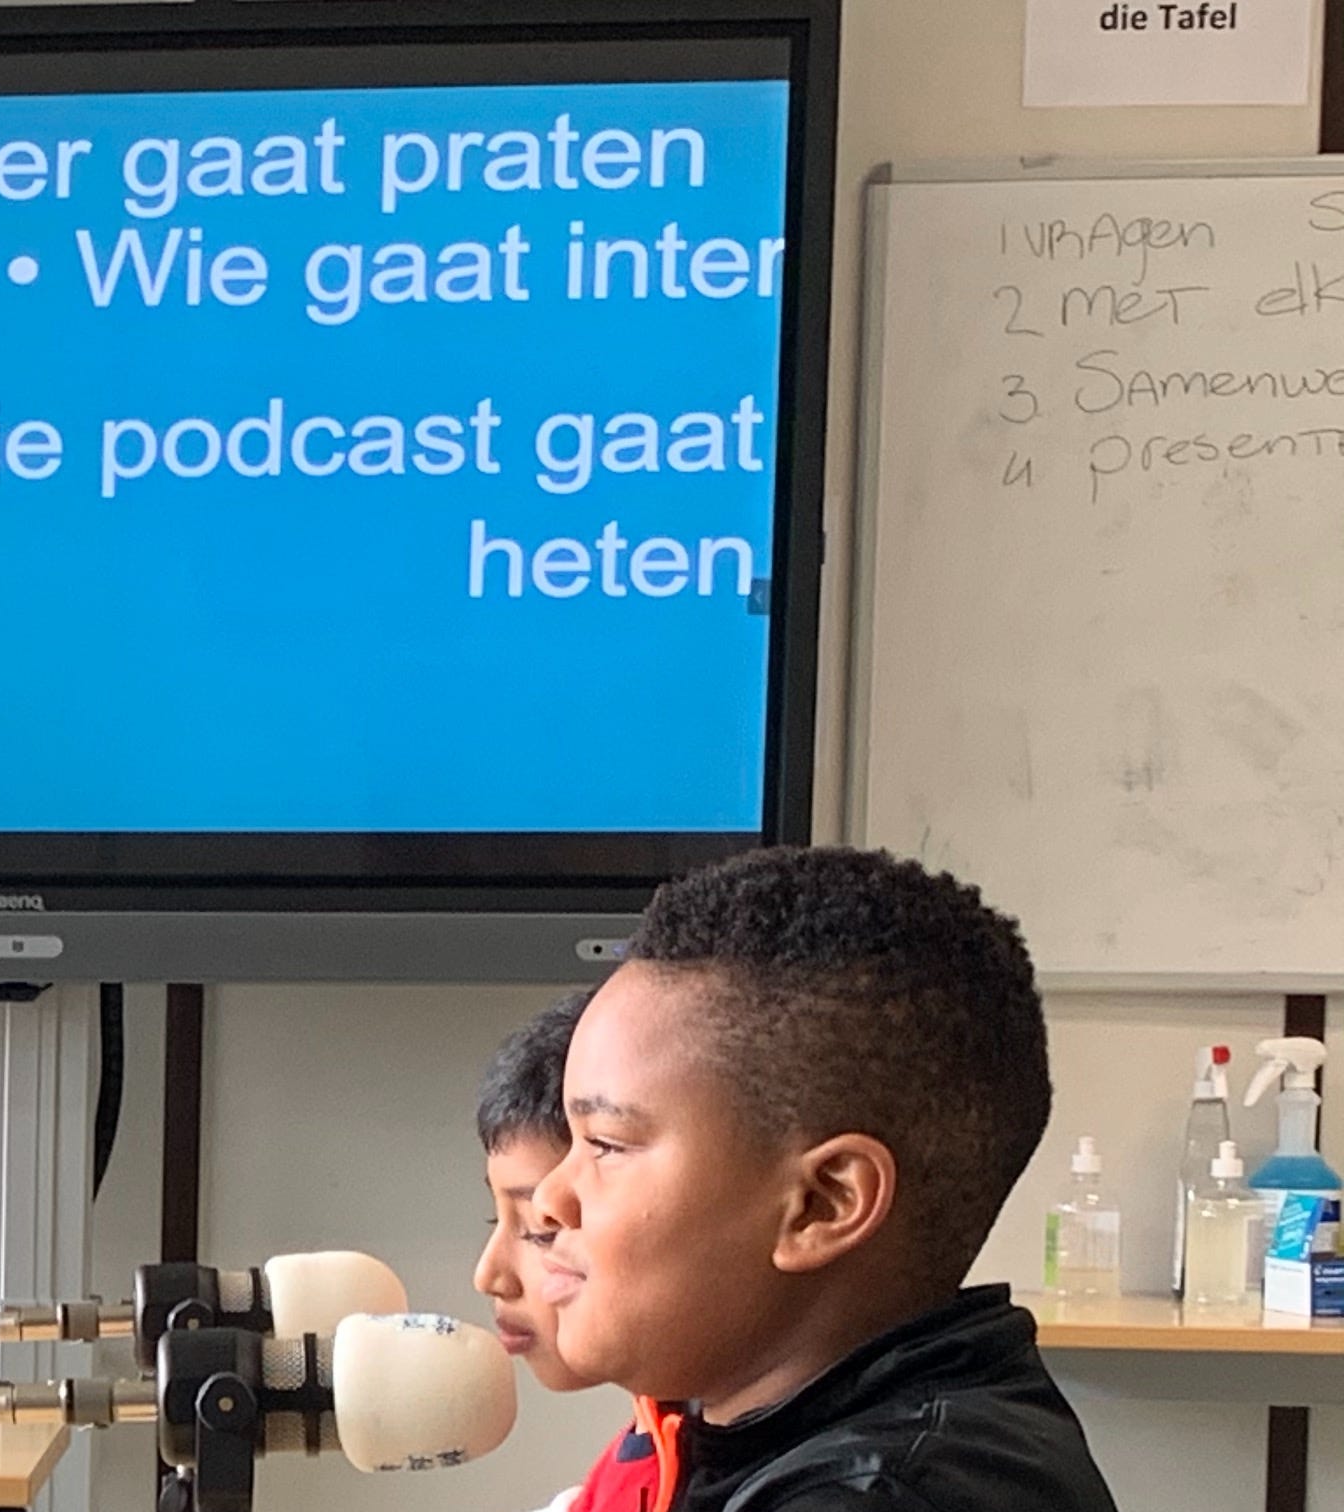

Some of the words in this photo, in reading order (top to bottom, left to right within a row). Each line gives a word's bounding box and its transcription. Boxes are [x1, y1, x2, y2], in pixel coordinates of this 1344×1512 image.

[1100, 3, 1148, 31] die
[1158, 2, 1238, 30] Tafel
[123, 118, 345, 218] gaat
[382, 114, 705, 213] praten
[77, 228, 267, 307] Wie
[305, 225, 530, 325] gaat
[568, 222, 784, 299] inter
[993, 284, 1044, 337] 2
[999, 374, 1038, 424] 3
[102, 398, 501, 497] podcast
[536, 394, 764, 493] gaat
[1002, 451, 1032, 487] 4
[470, 520, 753, 597] heten
